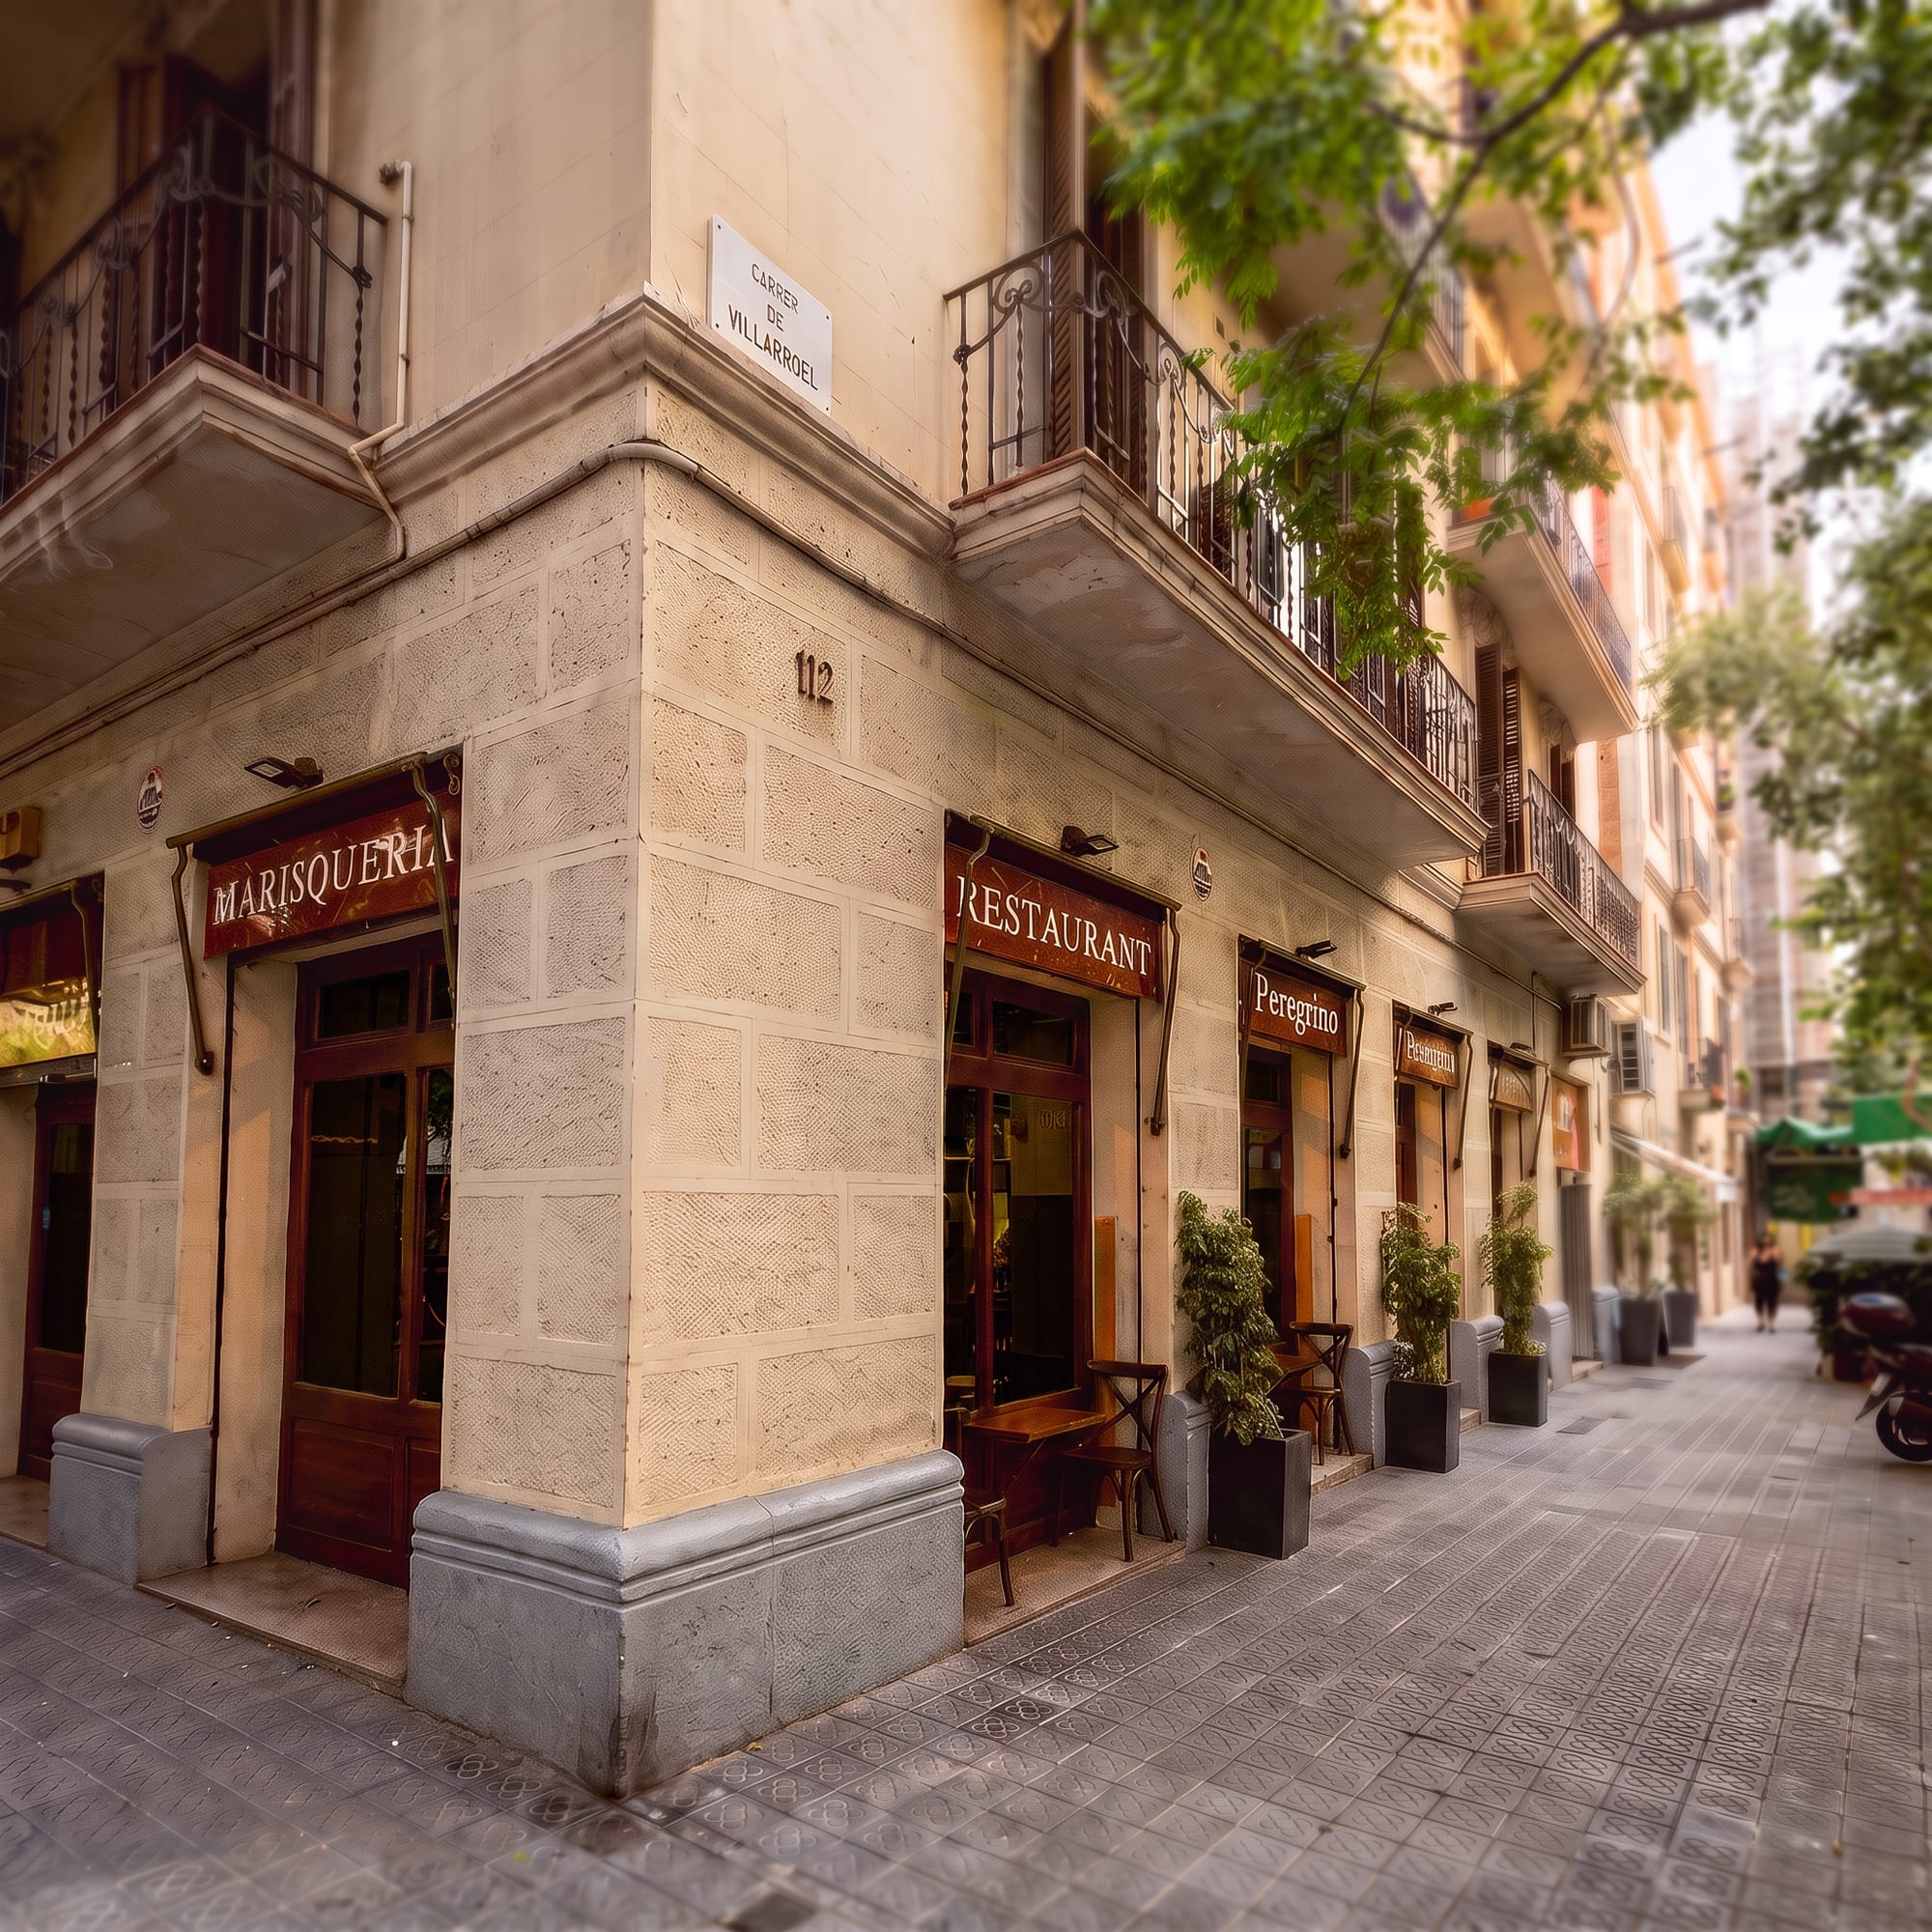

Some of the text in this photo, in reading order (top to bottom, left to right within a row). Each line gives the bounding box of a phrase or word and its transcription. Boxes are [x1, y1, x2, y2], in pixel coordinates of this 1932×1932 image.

[752, 263, 799, 314] CARRER
[767, 303, 784, 332] DE
[728, 303, 819, 391] VILLARROEL
[795, 649, 834, 705] 112
[956, 875, 1151, 976] RESTAURANT
[1255, 972, 1338, 1036] Peregrino
